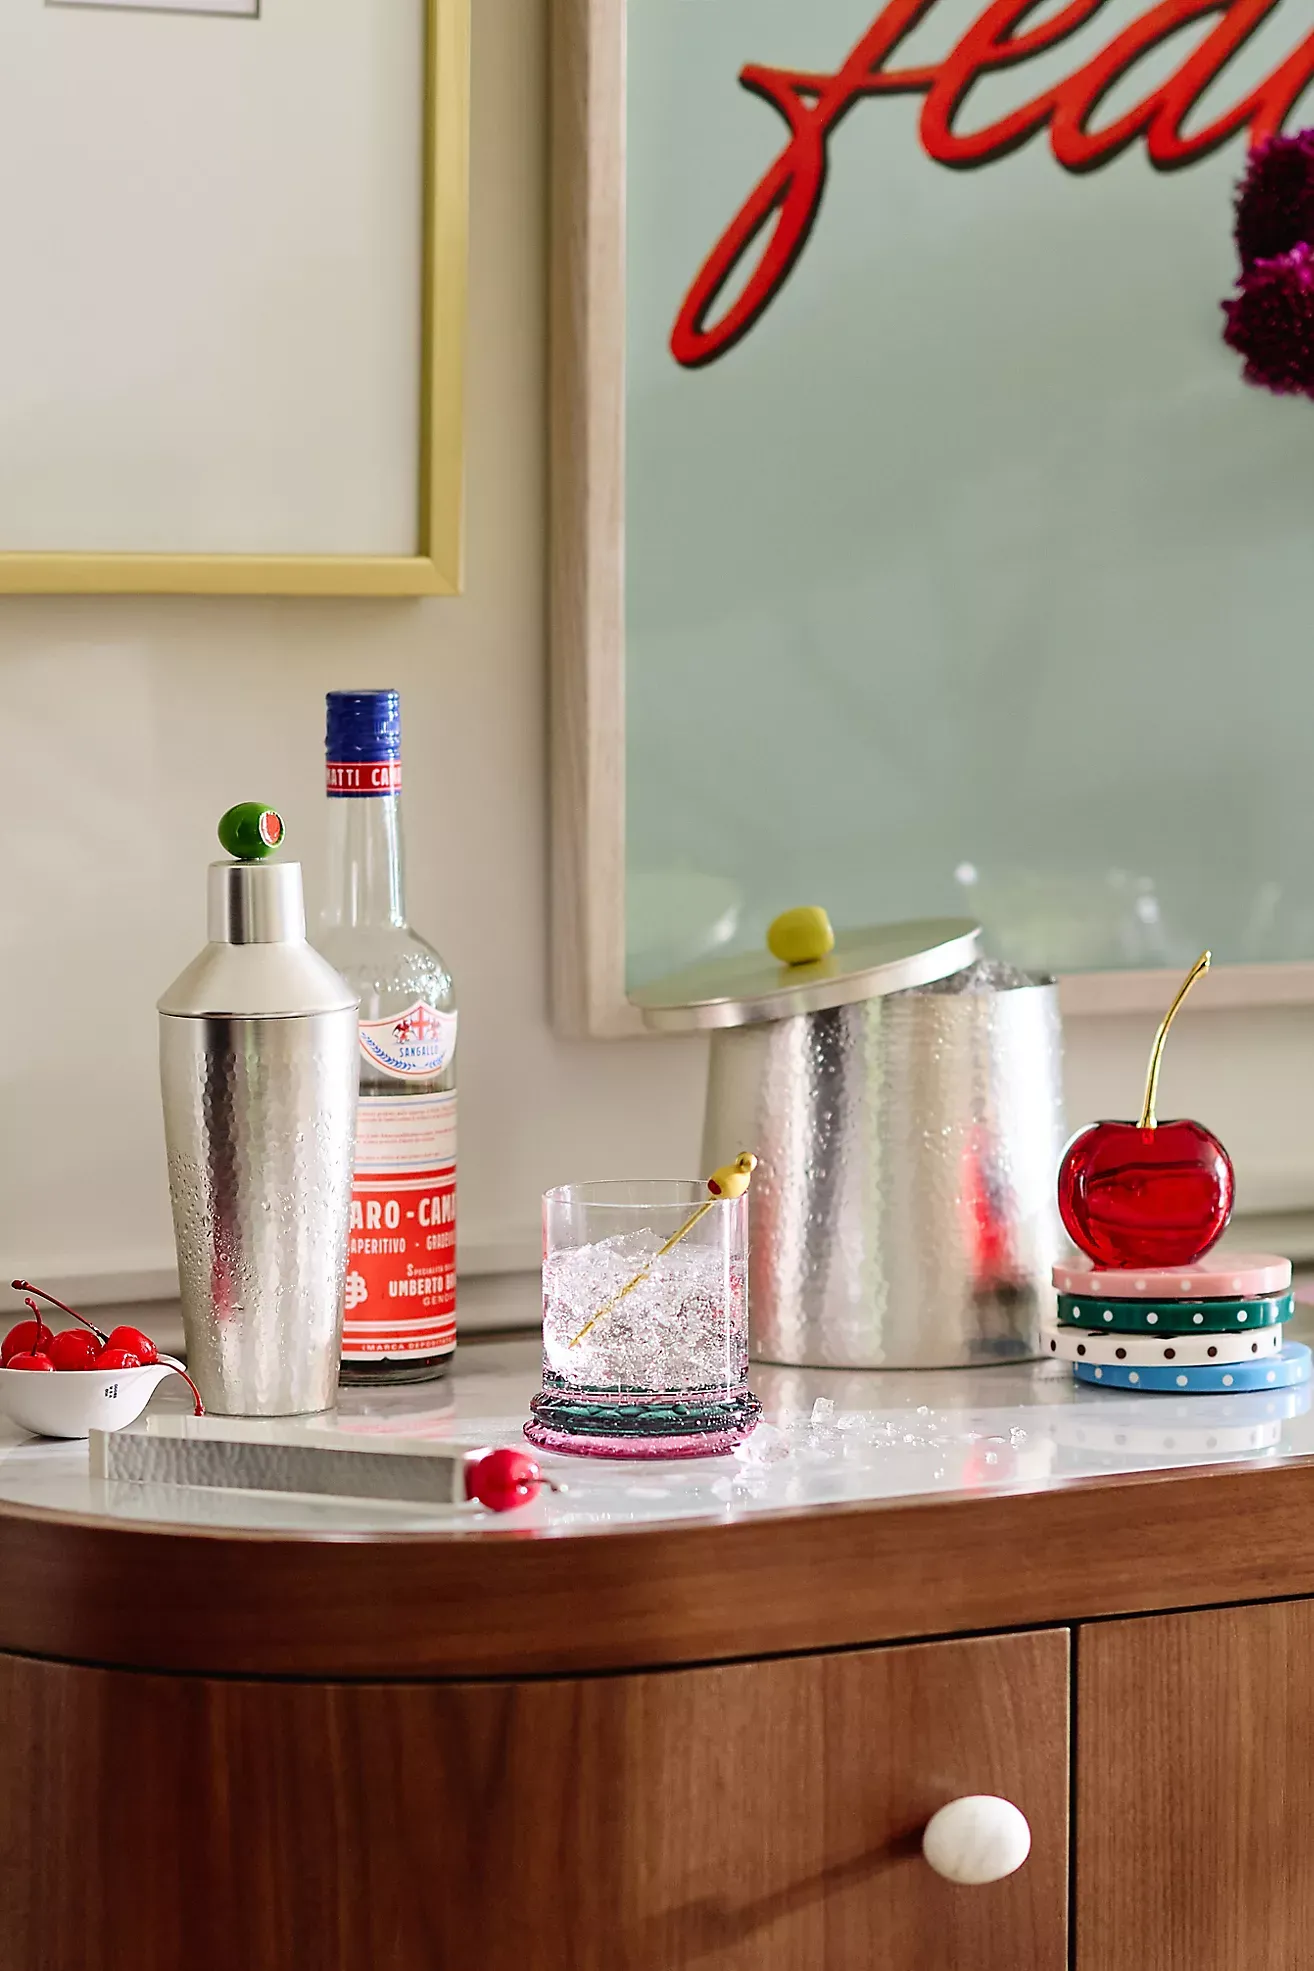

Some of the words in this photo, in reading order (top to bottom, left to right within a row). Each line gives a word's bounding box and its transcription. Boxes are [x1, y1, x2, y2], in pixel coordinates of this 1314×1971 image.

[327, 768, 360, 787] ATTI
[399, 1044, 439, 1058] SANGALLO
[350, 1237, 406, 1255] APERITIVO
[388, 1275, 444, 1297] UMBERTO
